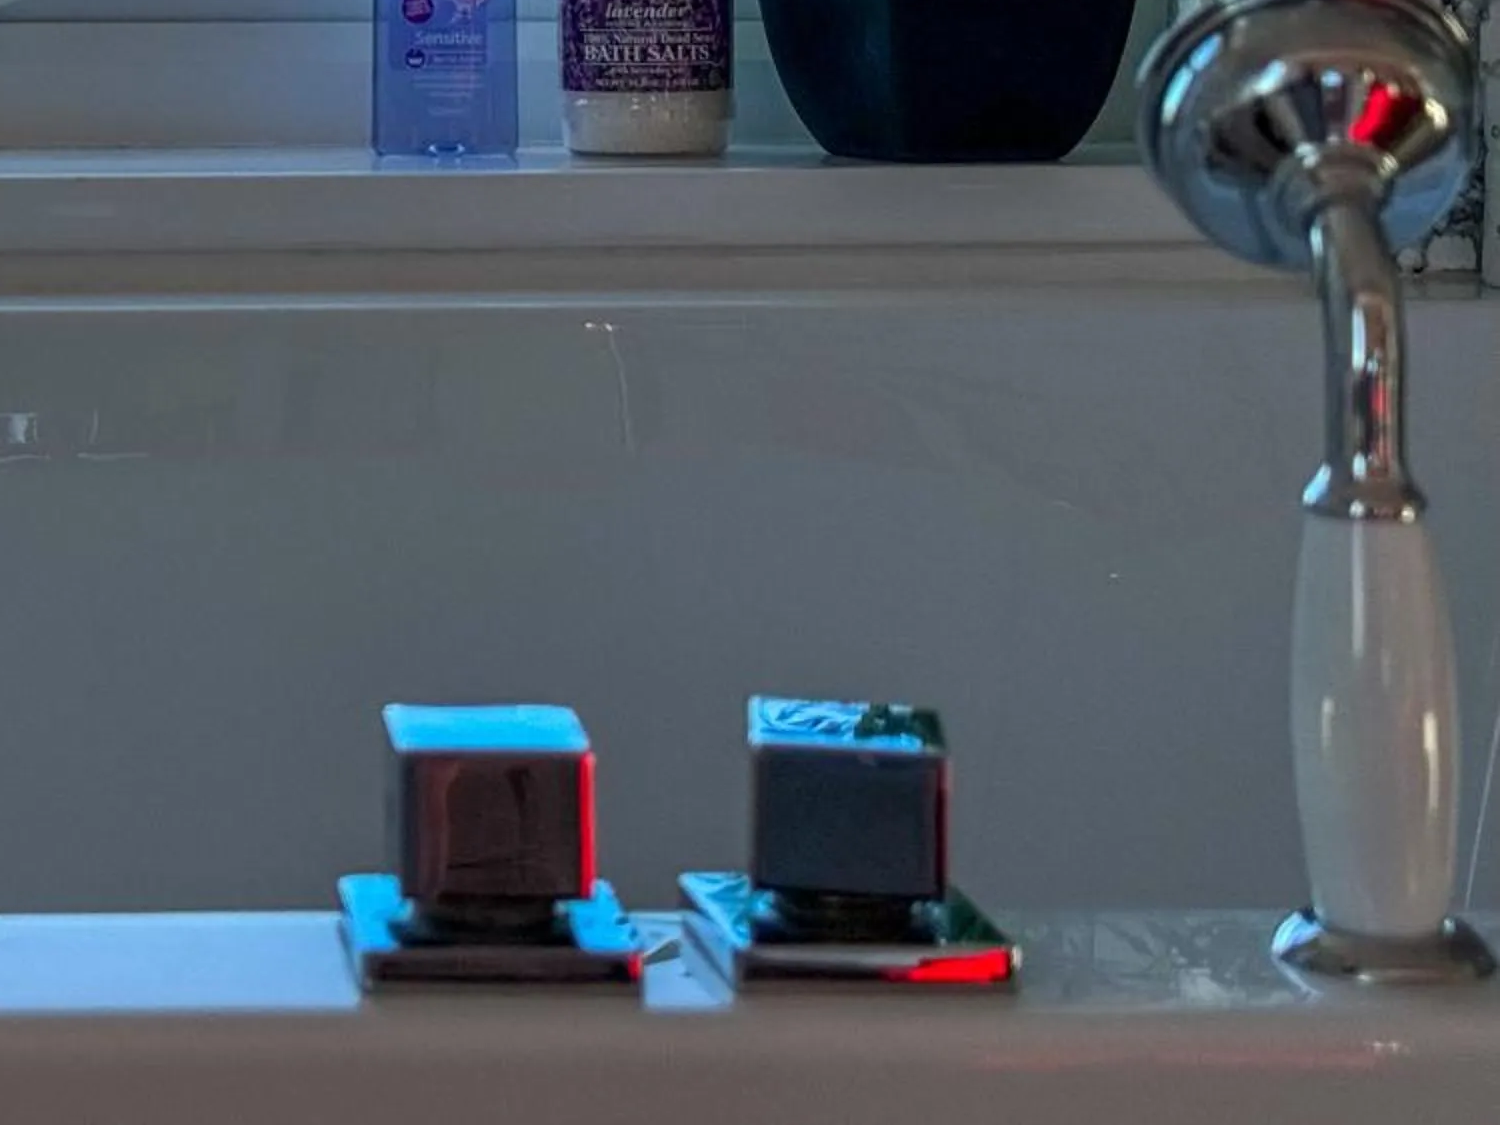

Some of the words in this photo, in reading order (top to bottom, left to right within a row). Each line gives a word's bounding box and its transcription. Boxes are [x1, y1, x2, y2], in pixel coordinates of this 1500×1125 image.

[605, 2, 687, 19] lavender
[415, 30, 483, 46] Sensitive
[585, 44, 642, 62] BATH
[647, 44, 710, 62] SALTS
